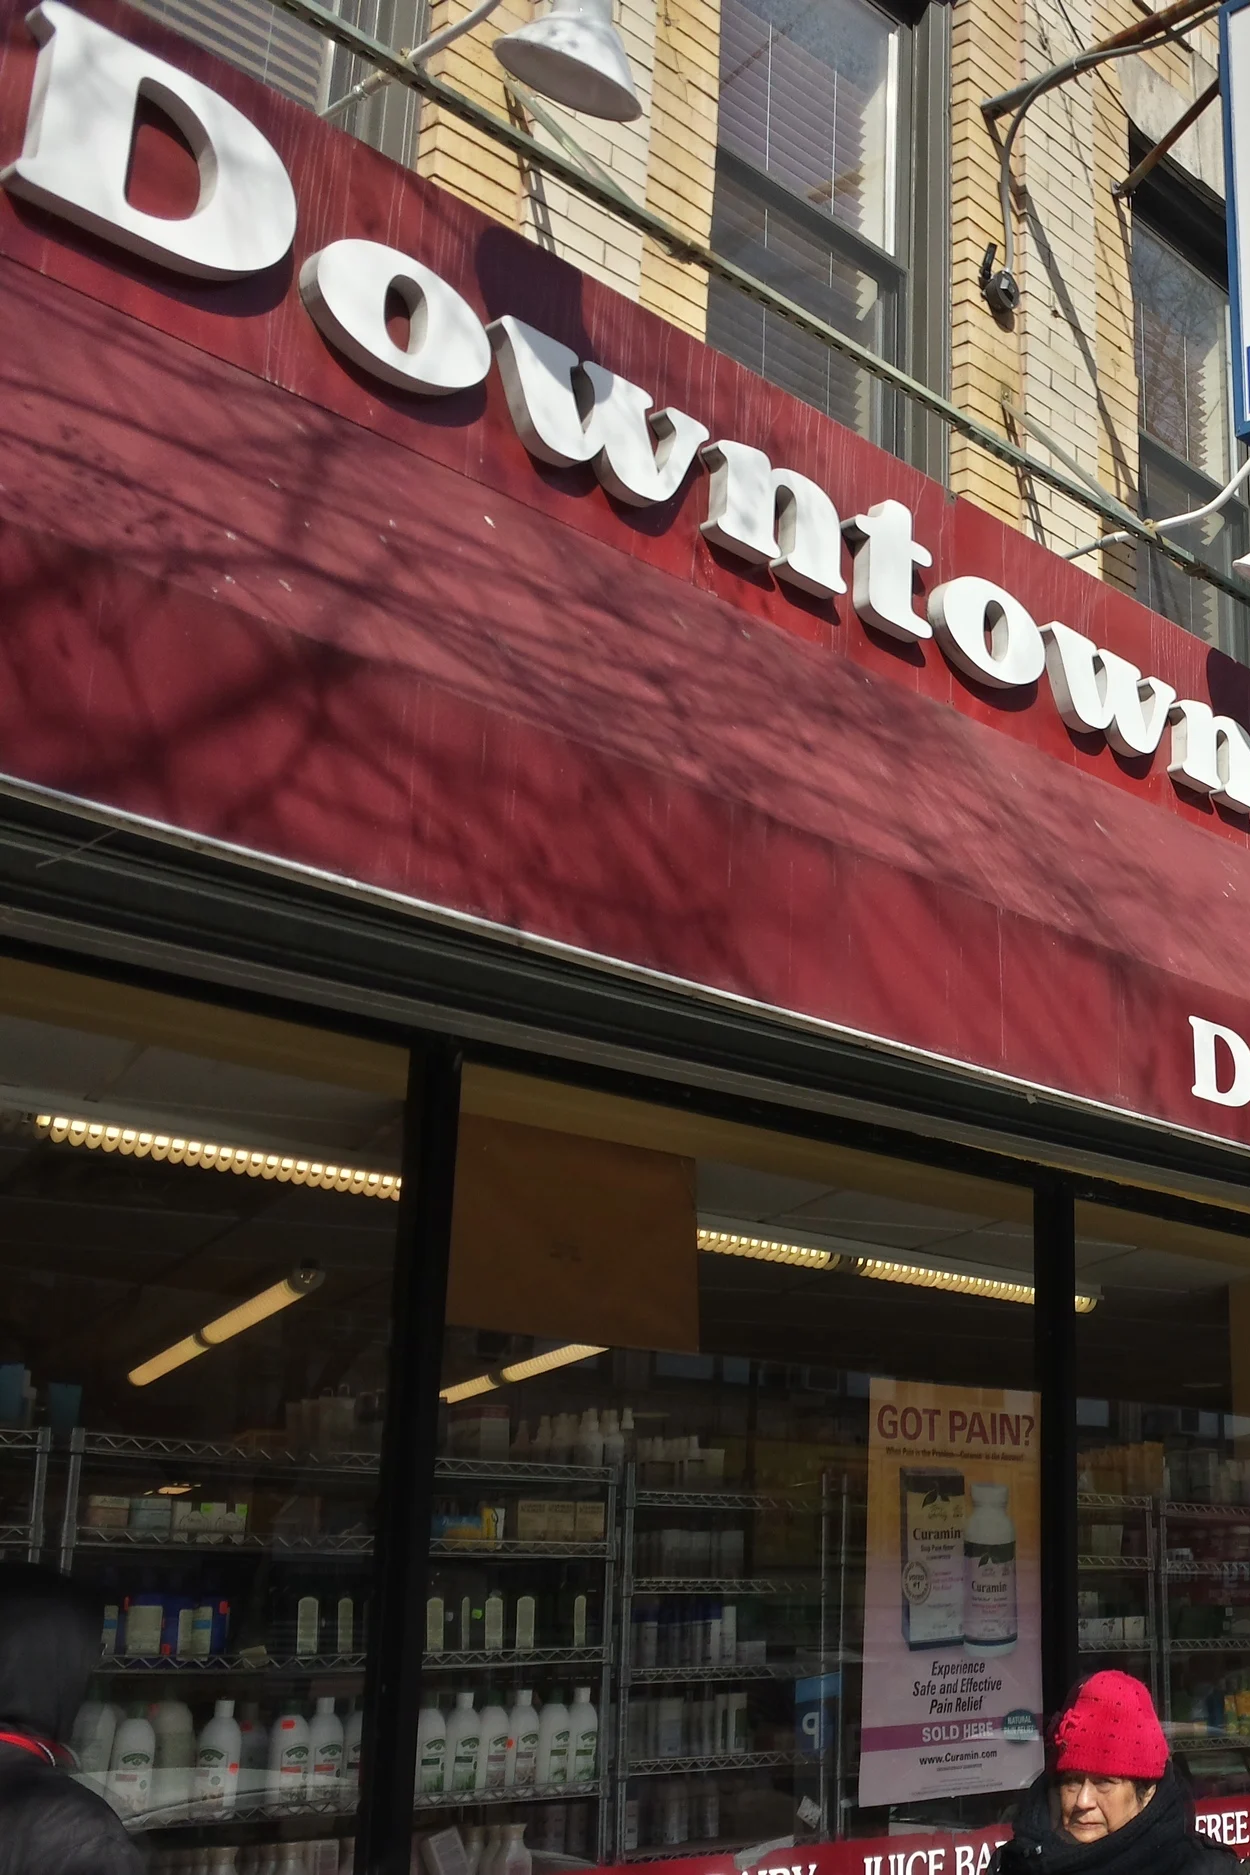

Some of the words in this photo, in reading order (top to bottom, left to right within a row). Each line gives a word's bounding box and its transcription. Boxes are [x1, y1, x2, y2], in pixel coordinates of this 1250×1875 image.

[877, 1404, 941, 1441] GOT
[949, 1410, 1035, 1446] PAIN?
[913, 1527, 961, 1541] Curamin
[972, 1580, 1007, 1592] Curamin
[931, 1660, 985, 1679] Experience
[913, 1680, 936, 1696] Safe
[940, 1678, 959, 1695] and
[960, 1677, 1002, 1693] Effective
[929, 1698, 953, 1714] Pain
[955, 1696, 983, 1713] Relief
[922, 1725, 959, 1742] SOLD
[963, 1722, 994, 1738] HERE
[919, 1750, 997, 1765] www.Curamin.com
[956, 1841, 1008, 1875] BA
